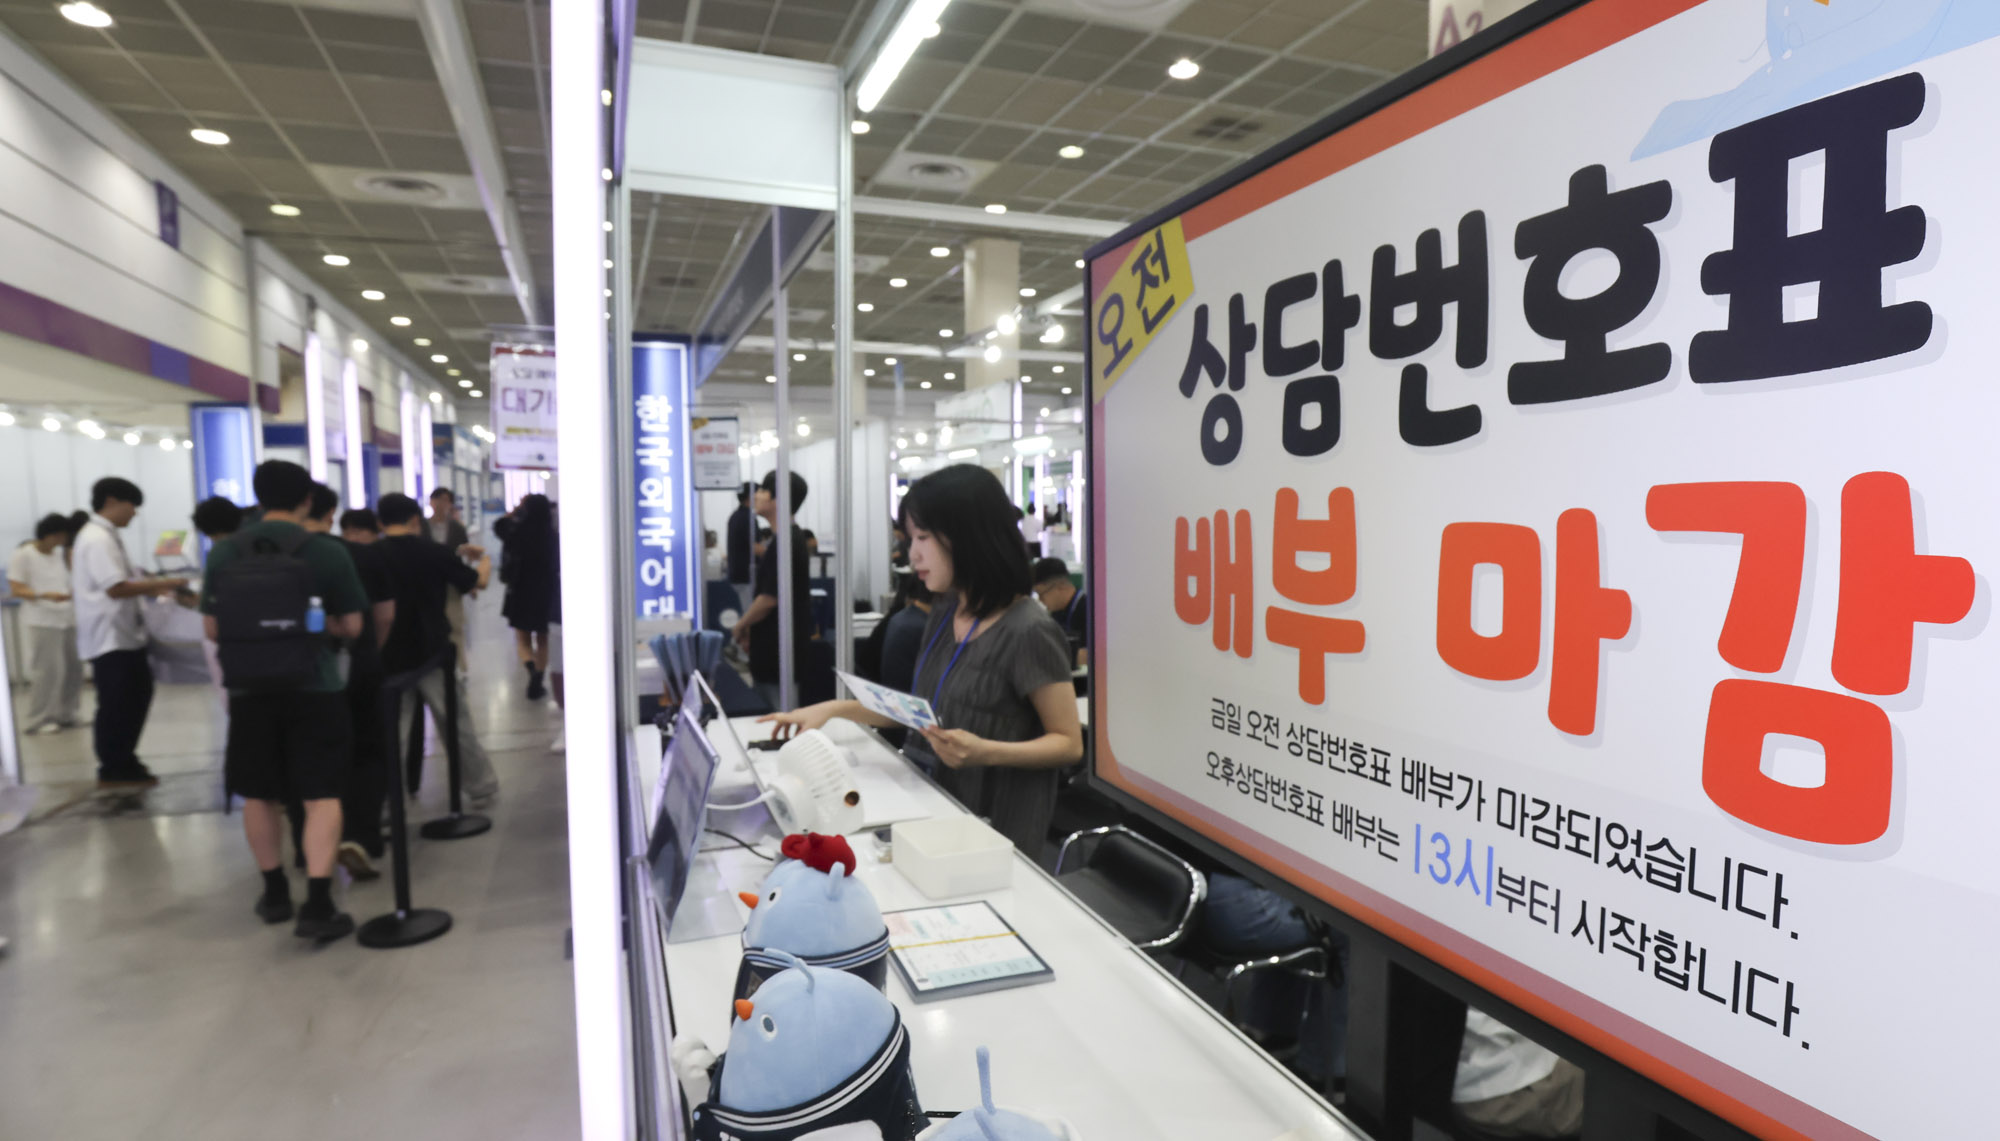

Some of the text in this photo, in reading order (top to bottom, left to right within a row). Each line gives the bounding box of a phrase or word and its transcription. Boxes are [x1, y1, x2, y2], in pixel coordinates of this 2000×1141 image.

[502, 386, 556, 416] 대기
[1097, 228, 1174, 380] 오전
[1179, 72, 1933, 467] 상담번호표
[1174, 470, 1976, 845] 배부 마감
[1205, 751, 1325, 828] 오후상담번호표
[1332, 799, 1400, 862] 배부는
[1570, 898, 1811, 1050] 시작합니다.
[1210, 697, 1800, 940] 금일 오전 상담번호표 배부가 마감되었습니다.
